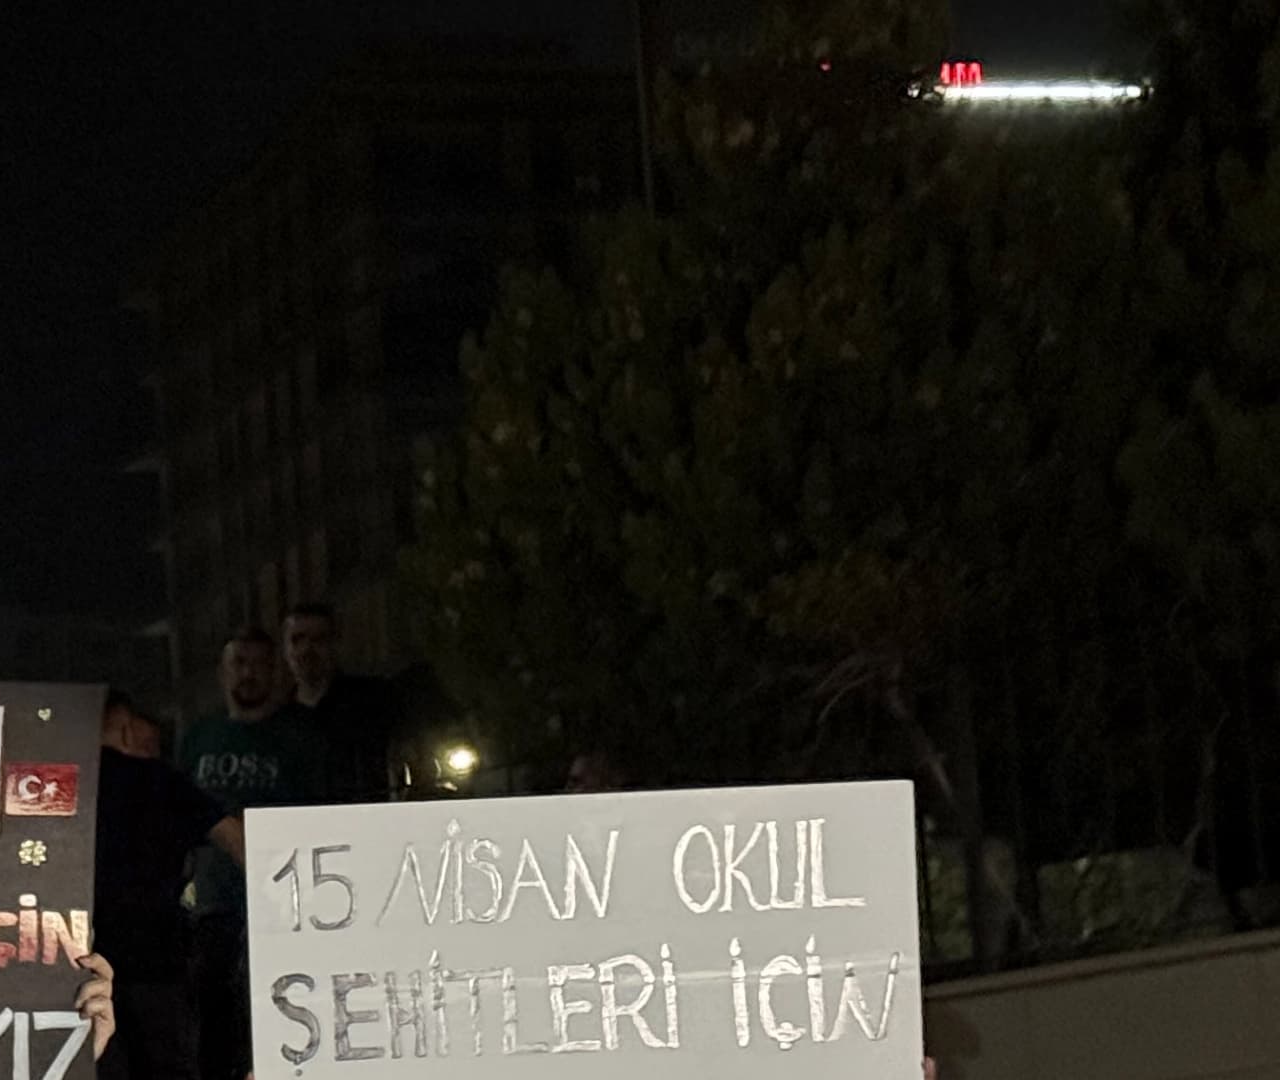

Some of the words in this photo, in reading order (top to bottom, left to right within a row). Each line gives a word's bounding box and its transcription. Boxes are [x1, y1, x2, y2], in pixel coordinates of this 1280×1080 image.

[272, 843, 355, 932] 15
[377, 818, 620, 925] NİSAN
[673, 818, 866, 914] OKUL
[271, 943, 680, 1077] ŞEHİTLERİ
[728, 934, 902, 1052] İÇİN
